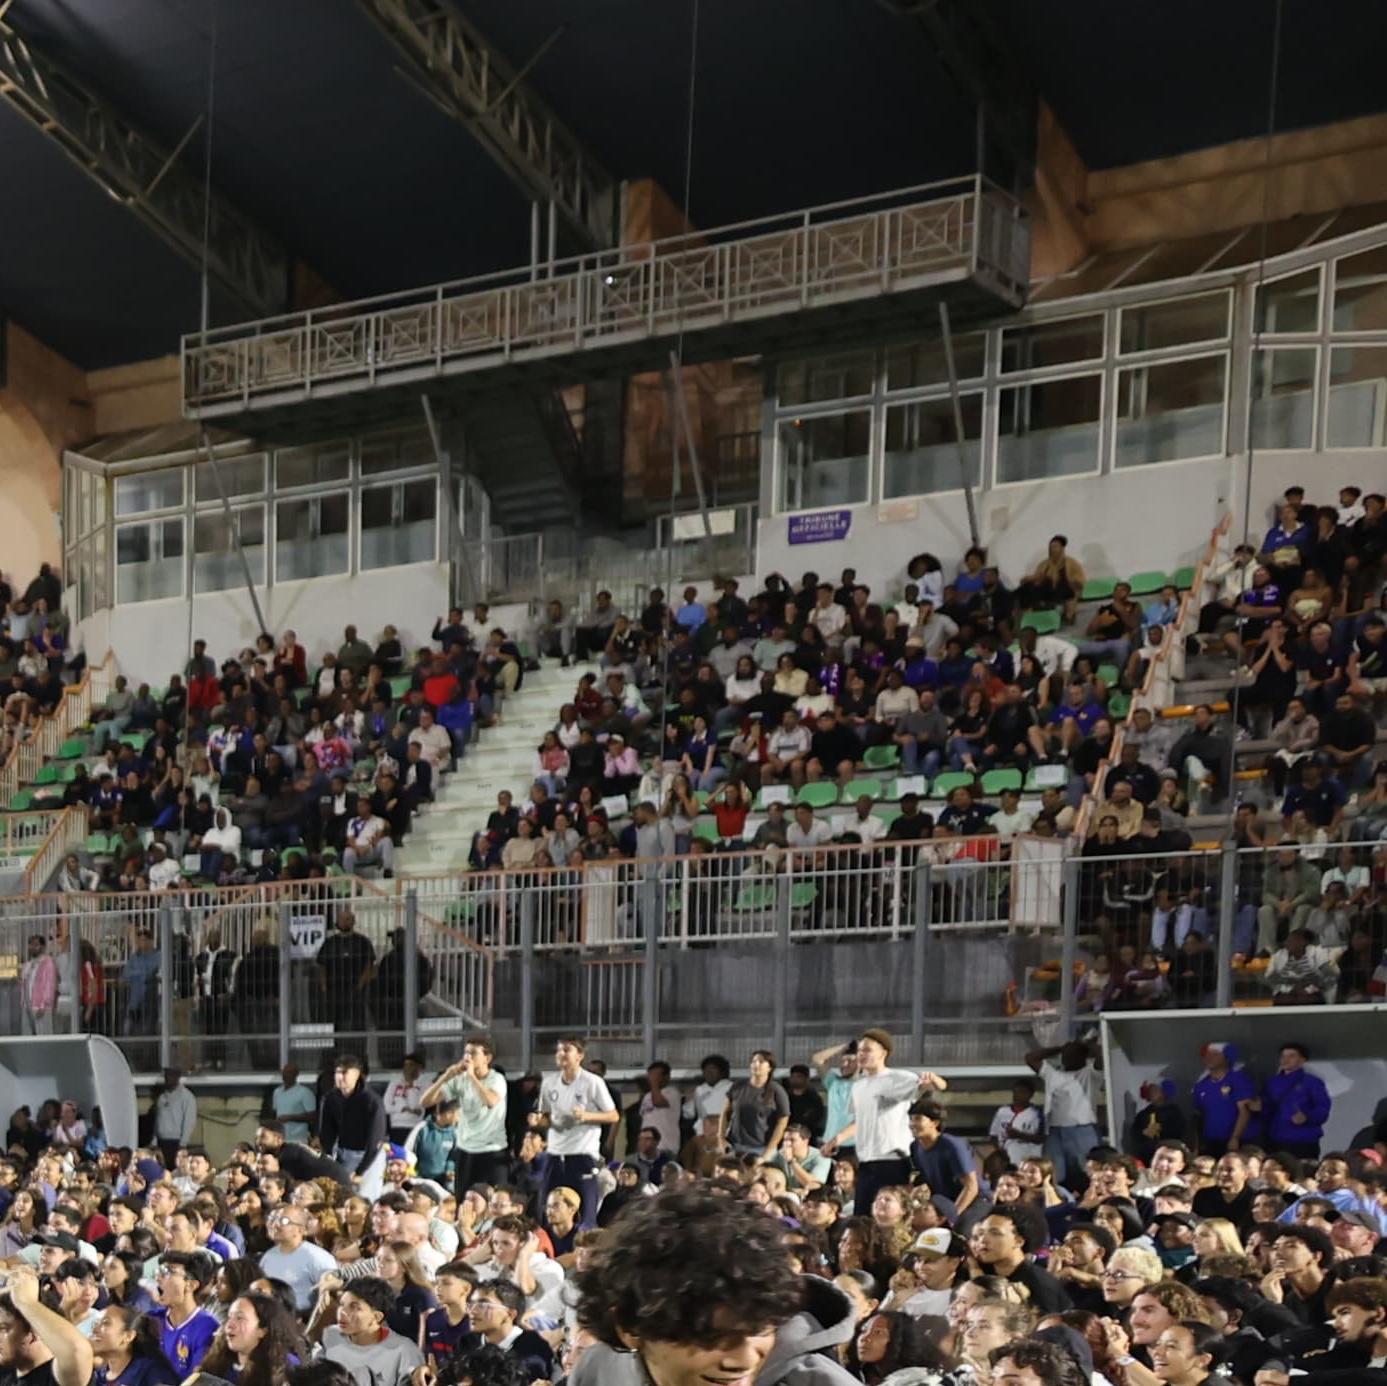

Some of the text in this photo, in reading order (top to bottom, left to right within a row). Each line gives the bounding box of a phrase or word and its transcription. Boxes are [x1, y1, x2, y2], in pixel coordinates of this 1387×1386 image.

[799, 512, 841, 525] TRIBUNE
[791, 520, 847, 534] OFFICIELLE
[290, 930, 323, 946] VIP
